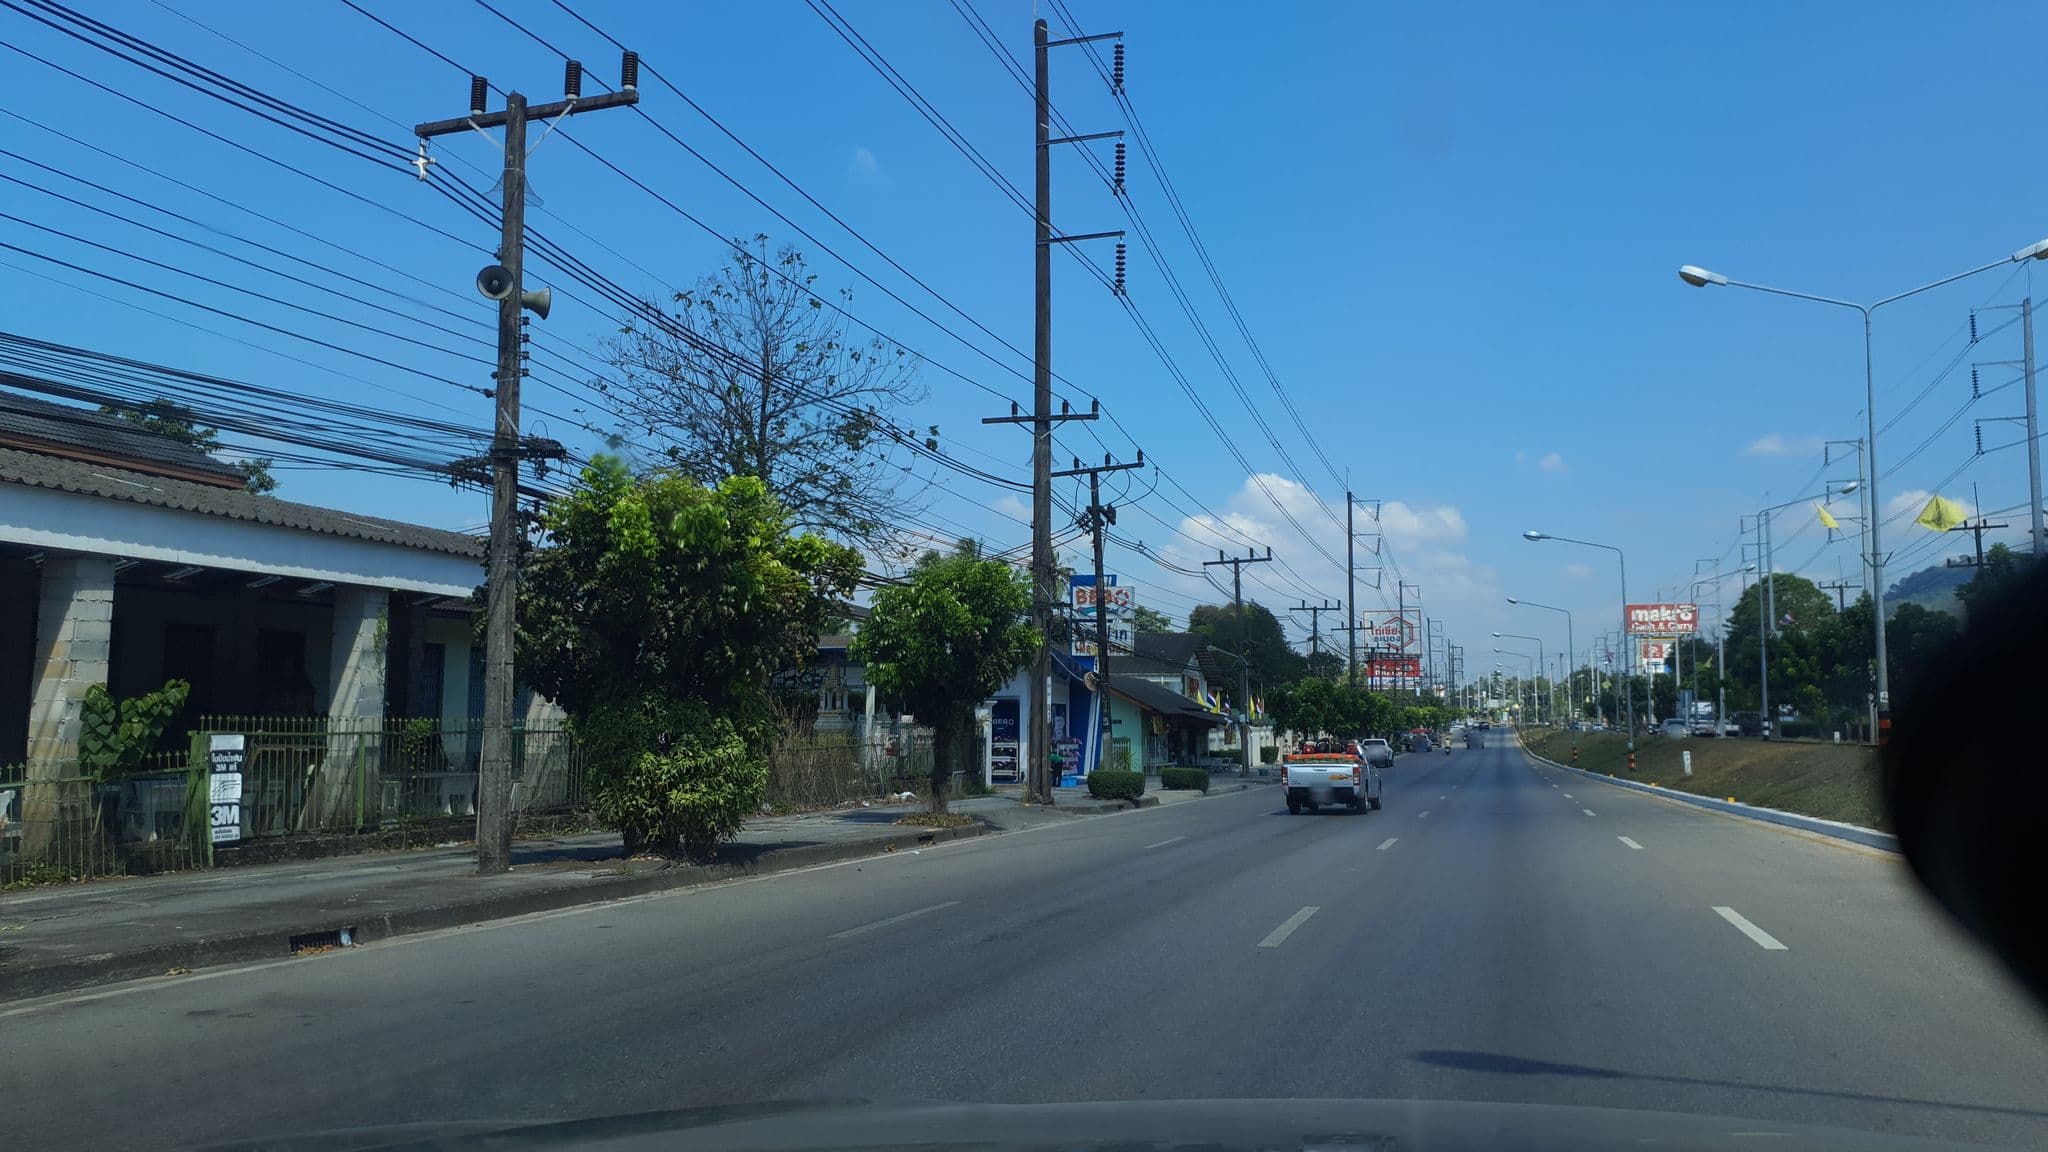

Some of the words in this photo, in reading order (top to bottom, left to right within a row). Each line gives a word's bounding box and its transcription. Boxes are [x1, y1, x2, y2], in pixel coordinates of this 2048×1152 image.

[1632, 606, 1693, 621] makro
[216, 763, 227, 772] 3M
[211, 805, 240, 825] 3M
